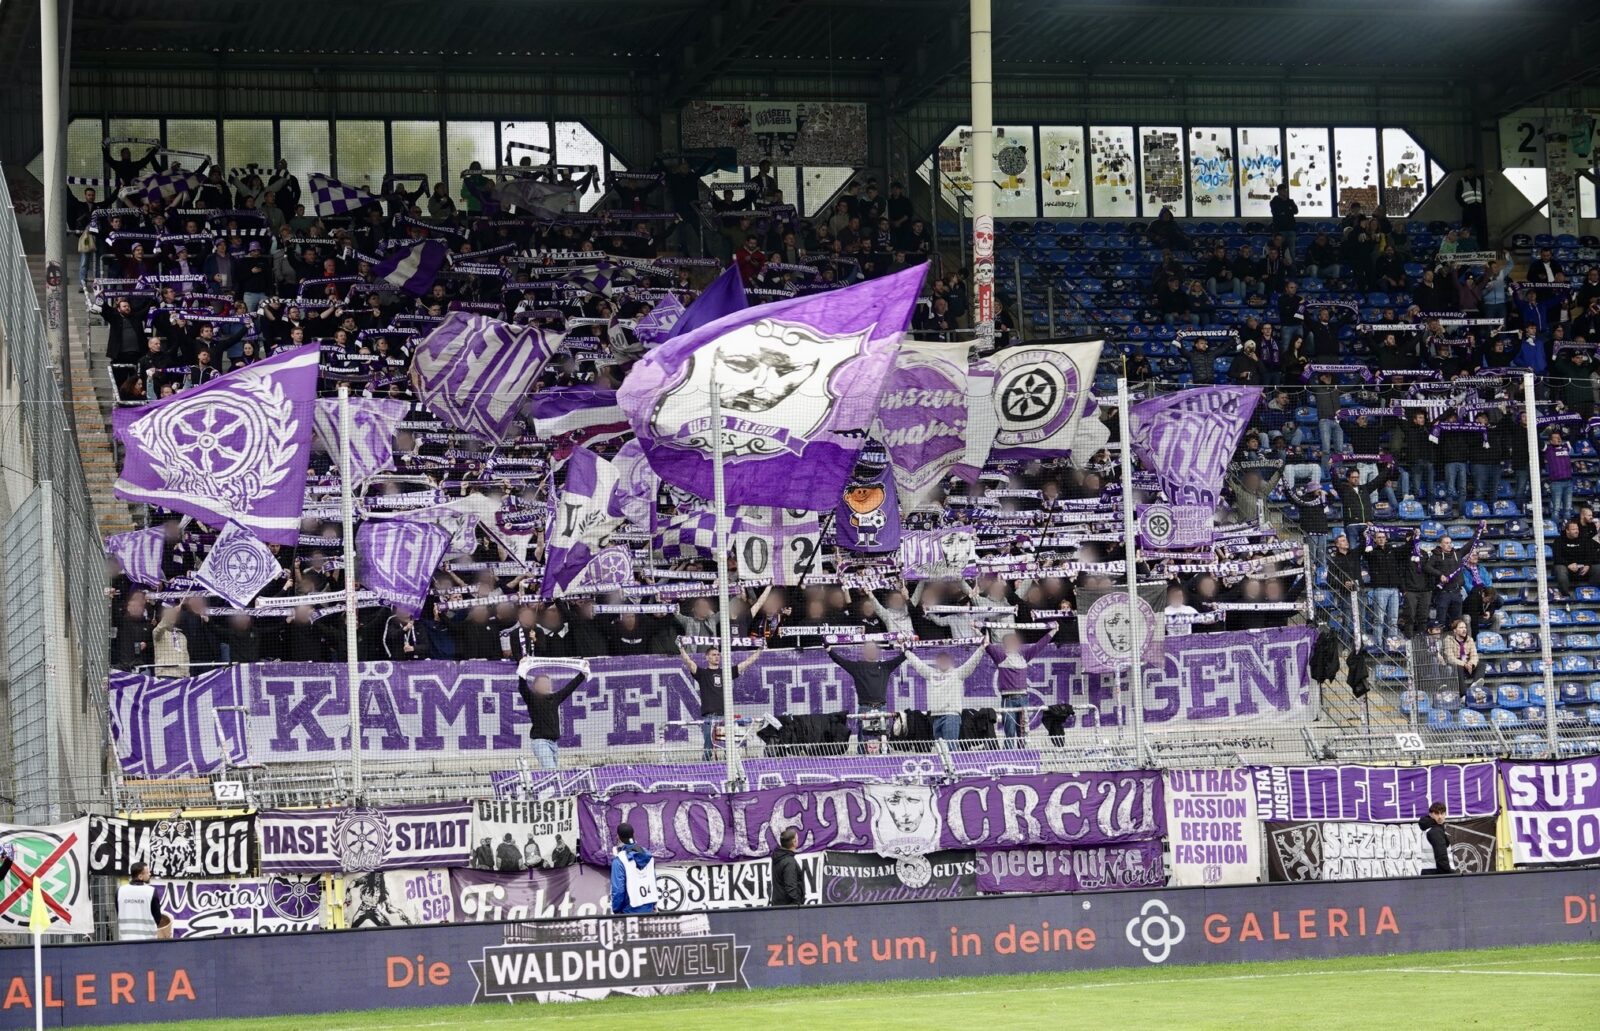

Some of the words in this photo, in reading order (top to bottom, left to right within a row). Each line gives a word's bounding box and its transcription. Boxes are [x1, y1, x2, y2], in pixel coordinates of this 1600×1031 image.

[1001, 570, 1036, 580] VIOLET
[1046, 569, 1077, 578] CREW
[1072, 560, 1126, 572] ULTRAS
[448, 595, 508, 610] INFERNO
[694, 636, 752, 646] ULTAS
[951, 636, 985, 646] CREW
[1399, 735, 1421, 748] 26
[218, 784, 240, 797] 27
[1169, 768, 1248, 793] ULTRAS
[1271, 766, 1290, 821] JUGEND
[1289, 762, 1498, 821] INFERNO
[1173, 798, 1247, 818] PASSION
[1255, 770, 1274, 820] ULTRA
[592, 792, 870, 860] VIOLET
[945, 777, 1158, 847] CREW
[1181, 822, 1243, 842] BEFORE
[264, 824, 328, 854] HASE
[395, 819, 469, 850] STADT
[1321, 821, 1423, 860] SEZION
[1175, 844, 1248, 865] FASHION
[405, 869, 443, 899] anti
[823, 864, 896, 879] CERVISIAM
[932, 861, 976, 878] GUYS
[159, 881, 268, 912] Marias
[826, 875, 963, 903] Osnabrück
[1204, 905, 1400, 944] GALERIA
[766, 933, 859, 967] zieht
[871, 935, 937, 963] um,
[950, 926, 981, 957] in
[994, 921, 1096, 955] deine
[386, 953, 450, 989] Die
[490, 946, 647, 986] WALDHOF
[649, 942, 730, 977] WELT
